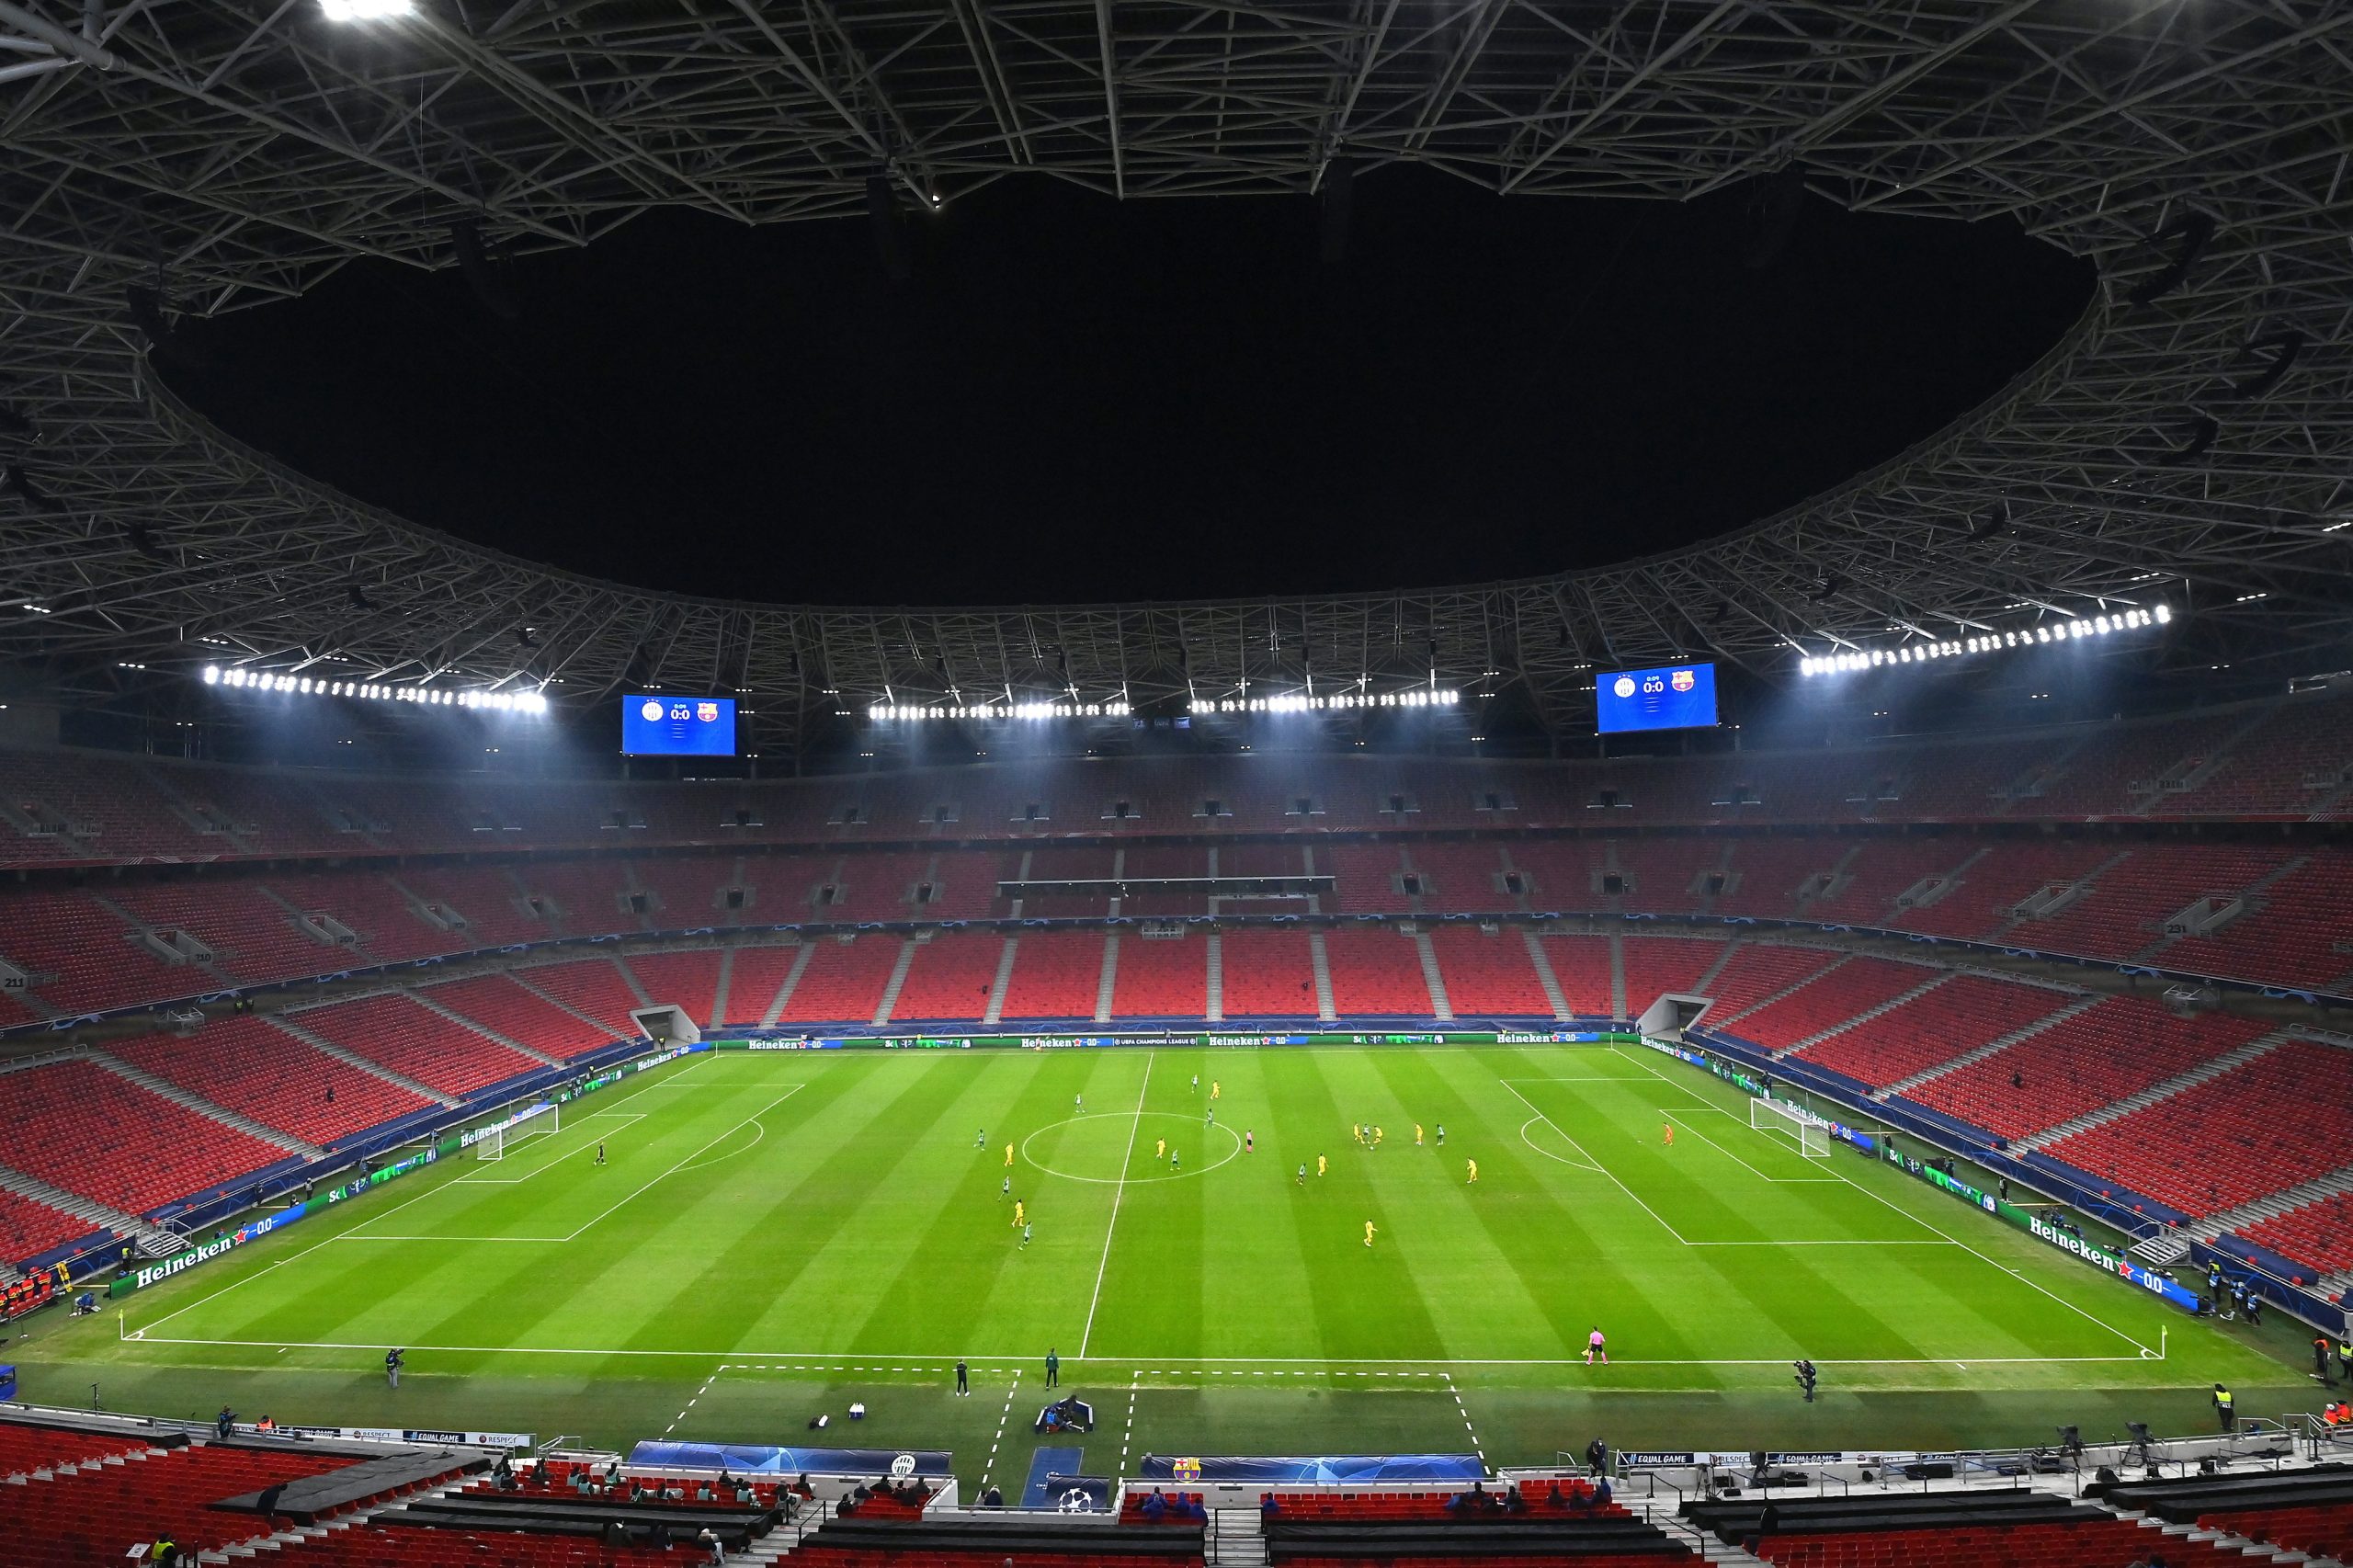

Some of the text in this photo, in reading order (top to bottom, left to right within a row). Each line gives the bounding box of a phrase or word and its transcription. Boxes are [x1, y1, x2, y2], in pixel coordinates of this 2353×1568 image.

[1643, 681, 1665, 693] 0:0
[670, 709, 690, 720] 0:0
[2167, 924, 2187, 934] 231
[5, 978, 24, 987] 211
[1209, 1036, 1260, 1046] Heineken
[1496, 1034, 1551, 1043] Heineken
[748, 1040, 798, 1050] Heineken
[1641, 1035, 1675, 1056] Heineken
[637, 1052, 672, 1072] Heineken
[460, 1119, 509, 1148] Heineken
[2029, 1215, 2115, 1272] Heineken
[136, 1236, 232, 1289] Heineken
[439, 1434, 460, 1443] GAME
[488, 1436, 517, 1444] RESPECT
[1663, 1455, 1687, 1463] GAME
